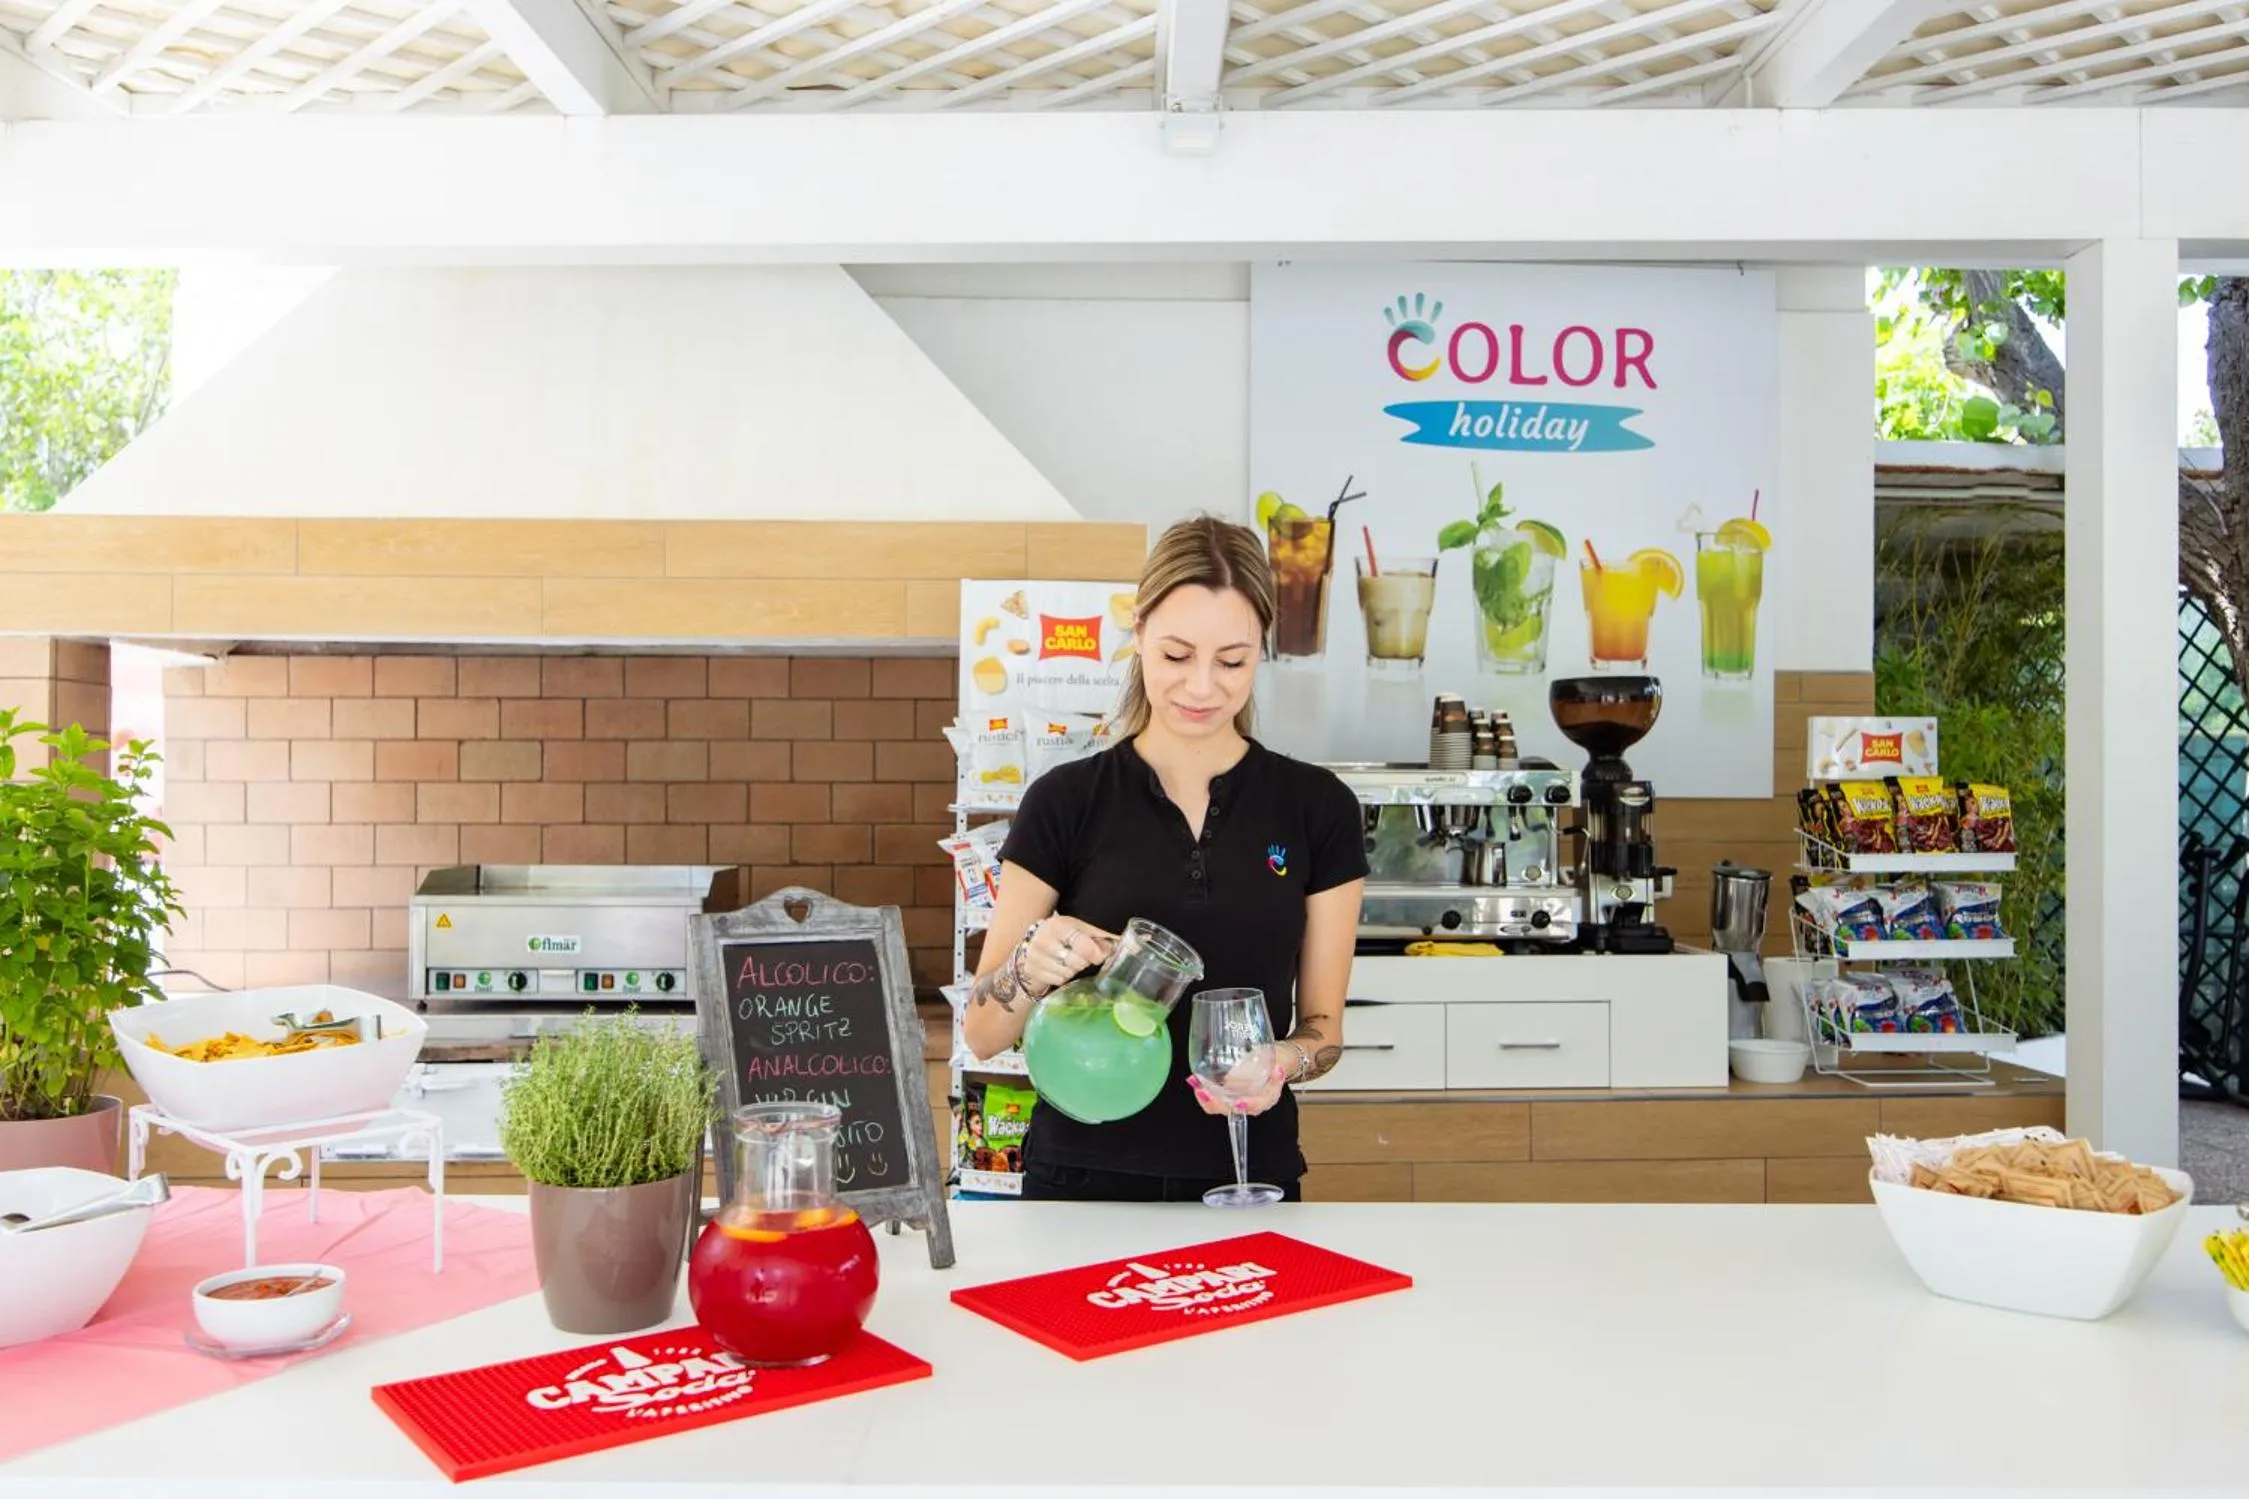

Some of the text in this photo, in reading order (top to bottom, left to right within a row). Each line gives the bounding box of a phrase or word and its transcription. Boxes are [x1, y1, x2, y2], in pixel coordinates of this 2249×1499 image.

[1385, 314, 1658, 390] COLOR
[1447, 401, 1591, 451] holiday
[1044, 637, 1097, 651] CARLO
[1054, 624, 1088, 637] SAN
[1016, 673, 1024, 685] Il
[1066, 674, 1090, 686] della
[1864, 747, 1900, 757] CARLO
[1872, 738, 1894, 748] SAN
[736, 955, 876, 989] ALCOLICO:
[738, 993, 834, 1021] ORANGE
[771, 1017, 853, 1046] SPRITZ
[1087, 1261, 1278, 1309] CAMPARI
[1150, 1279, 1266, 1311] Soda
[591, 1370, 756, 1413] Soda
